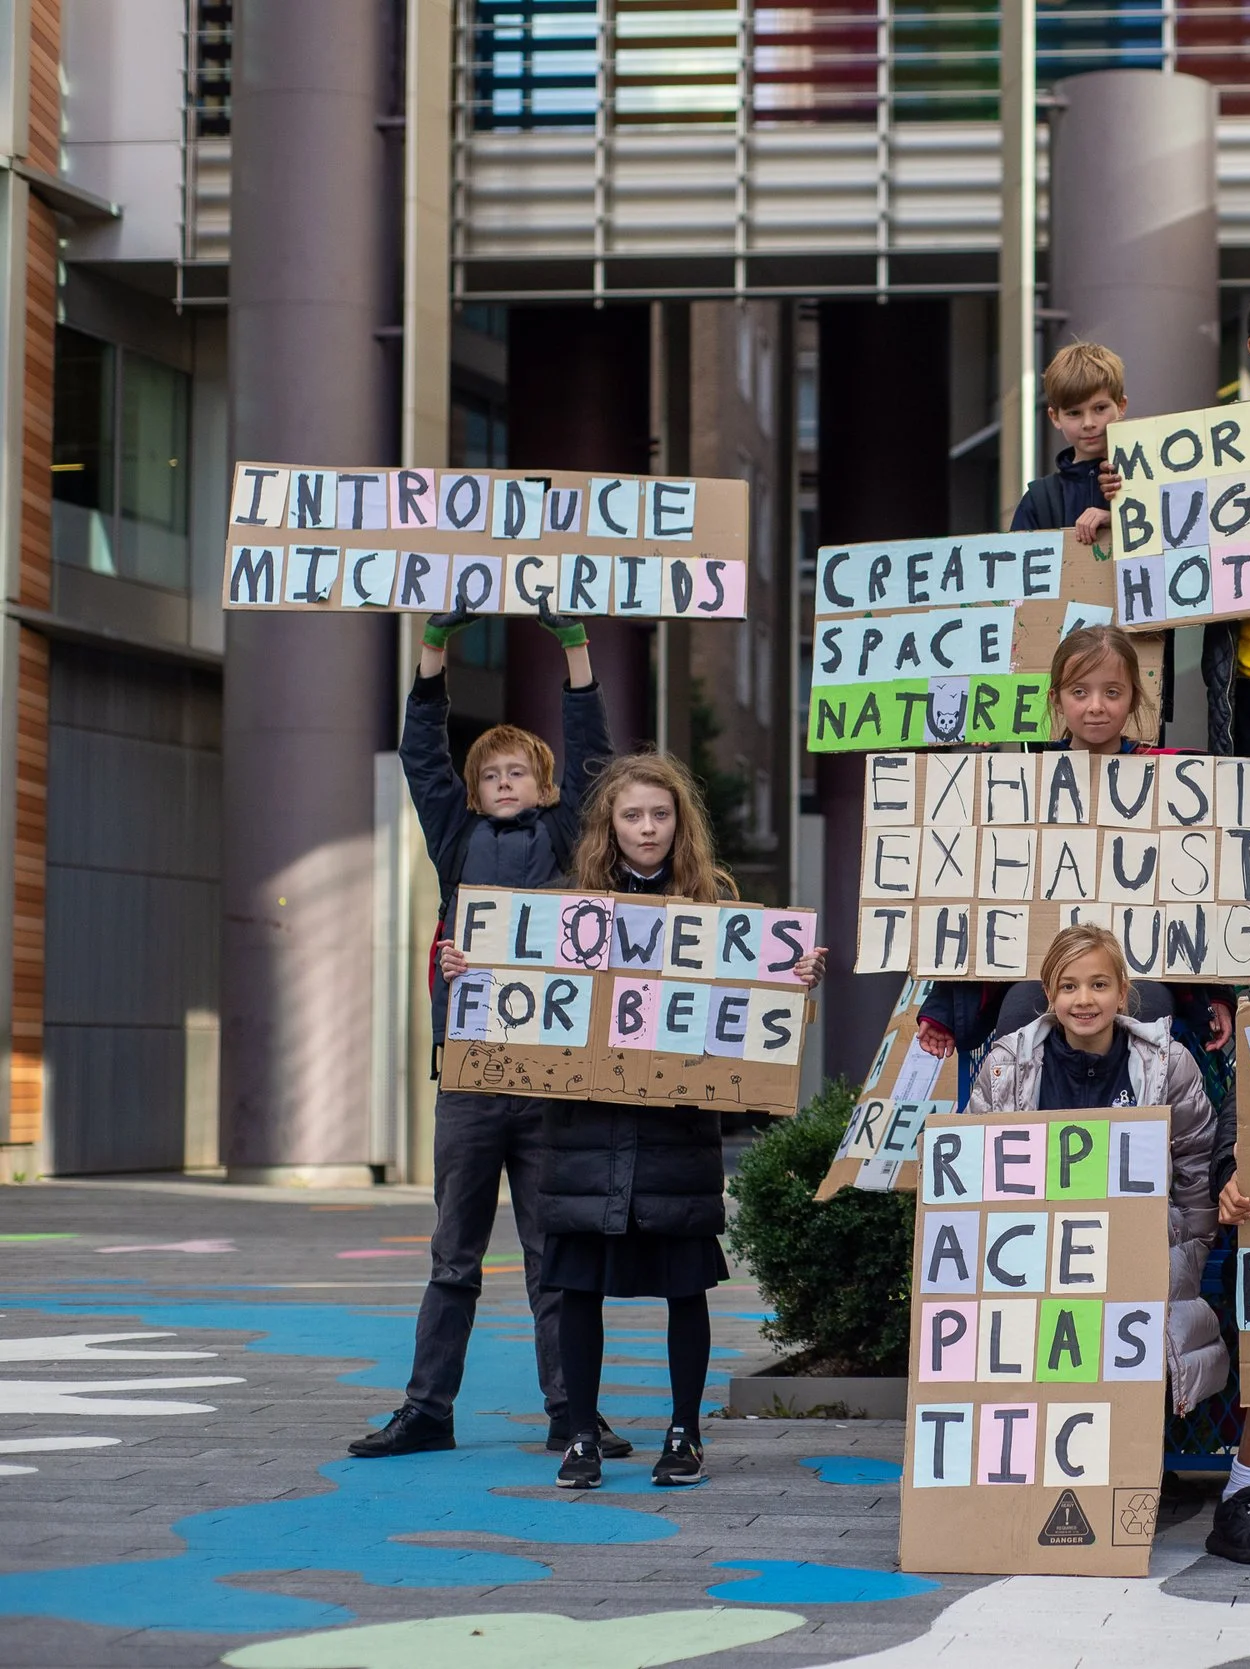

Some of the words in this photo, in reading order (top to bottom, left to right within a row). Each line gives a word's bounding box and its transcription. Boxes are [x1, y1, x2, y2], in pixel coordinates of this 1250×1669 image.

[236, 469, 693, 539] INTRODUCE
[230, 547, 725, 613] MICROGRIDS
[823, 545, 1055, 607] CREATE
[821, 619, 999, 677] SPACE
[816, 684, 1040, 742] NATURE
[462, 899, 803, 973] FLOWERS
[874, 907, 1024, 970] THE
[457, 979, 578, 1031] FOR
[617, 989, 791, 1050] BEES
[933, 1125, 1155, 1197] REPL
[928, 1219, 1102, 1287] ACE
[931, 1309, 1151, 1373] PLAS
[921, 1409, 1094, 1484] TIC
